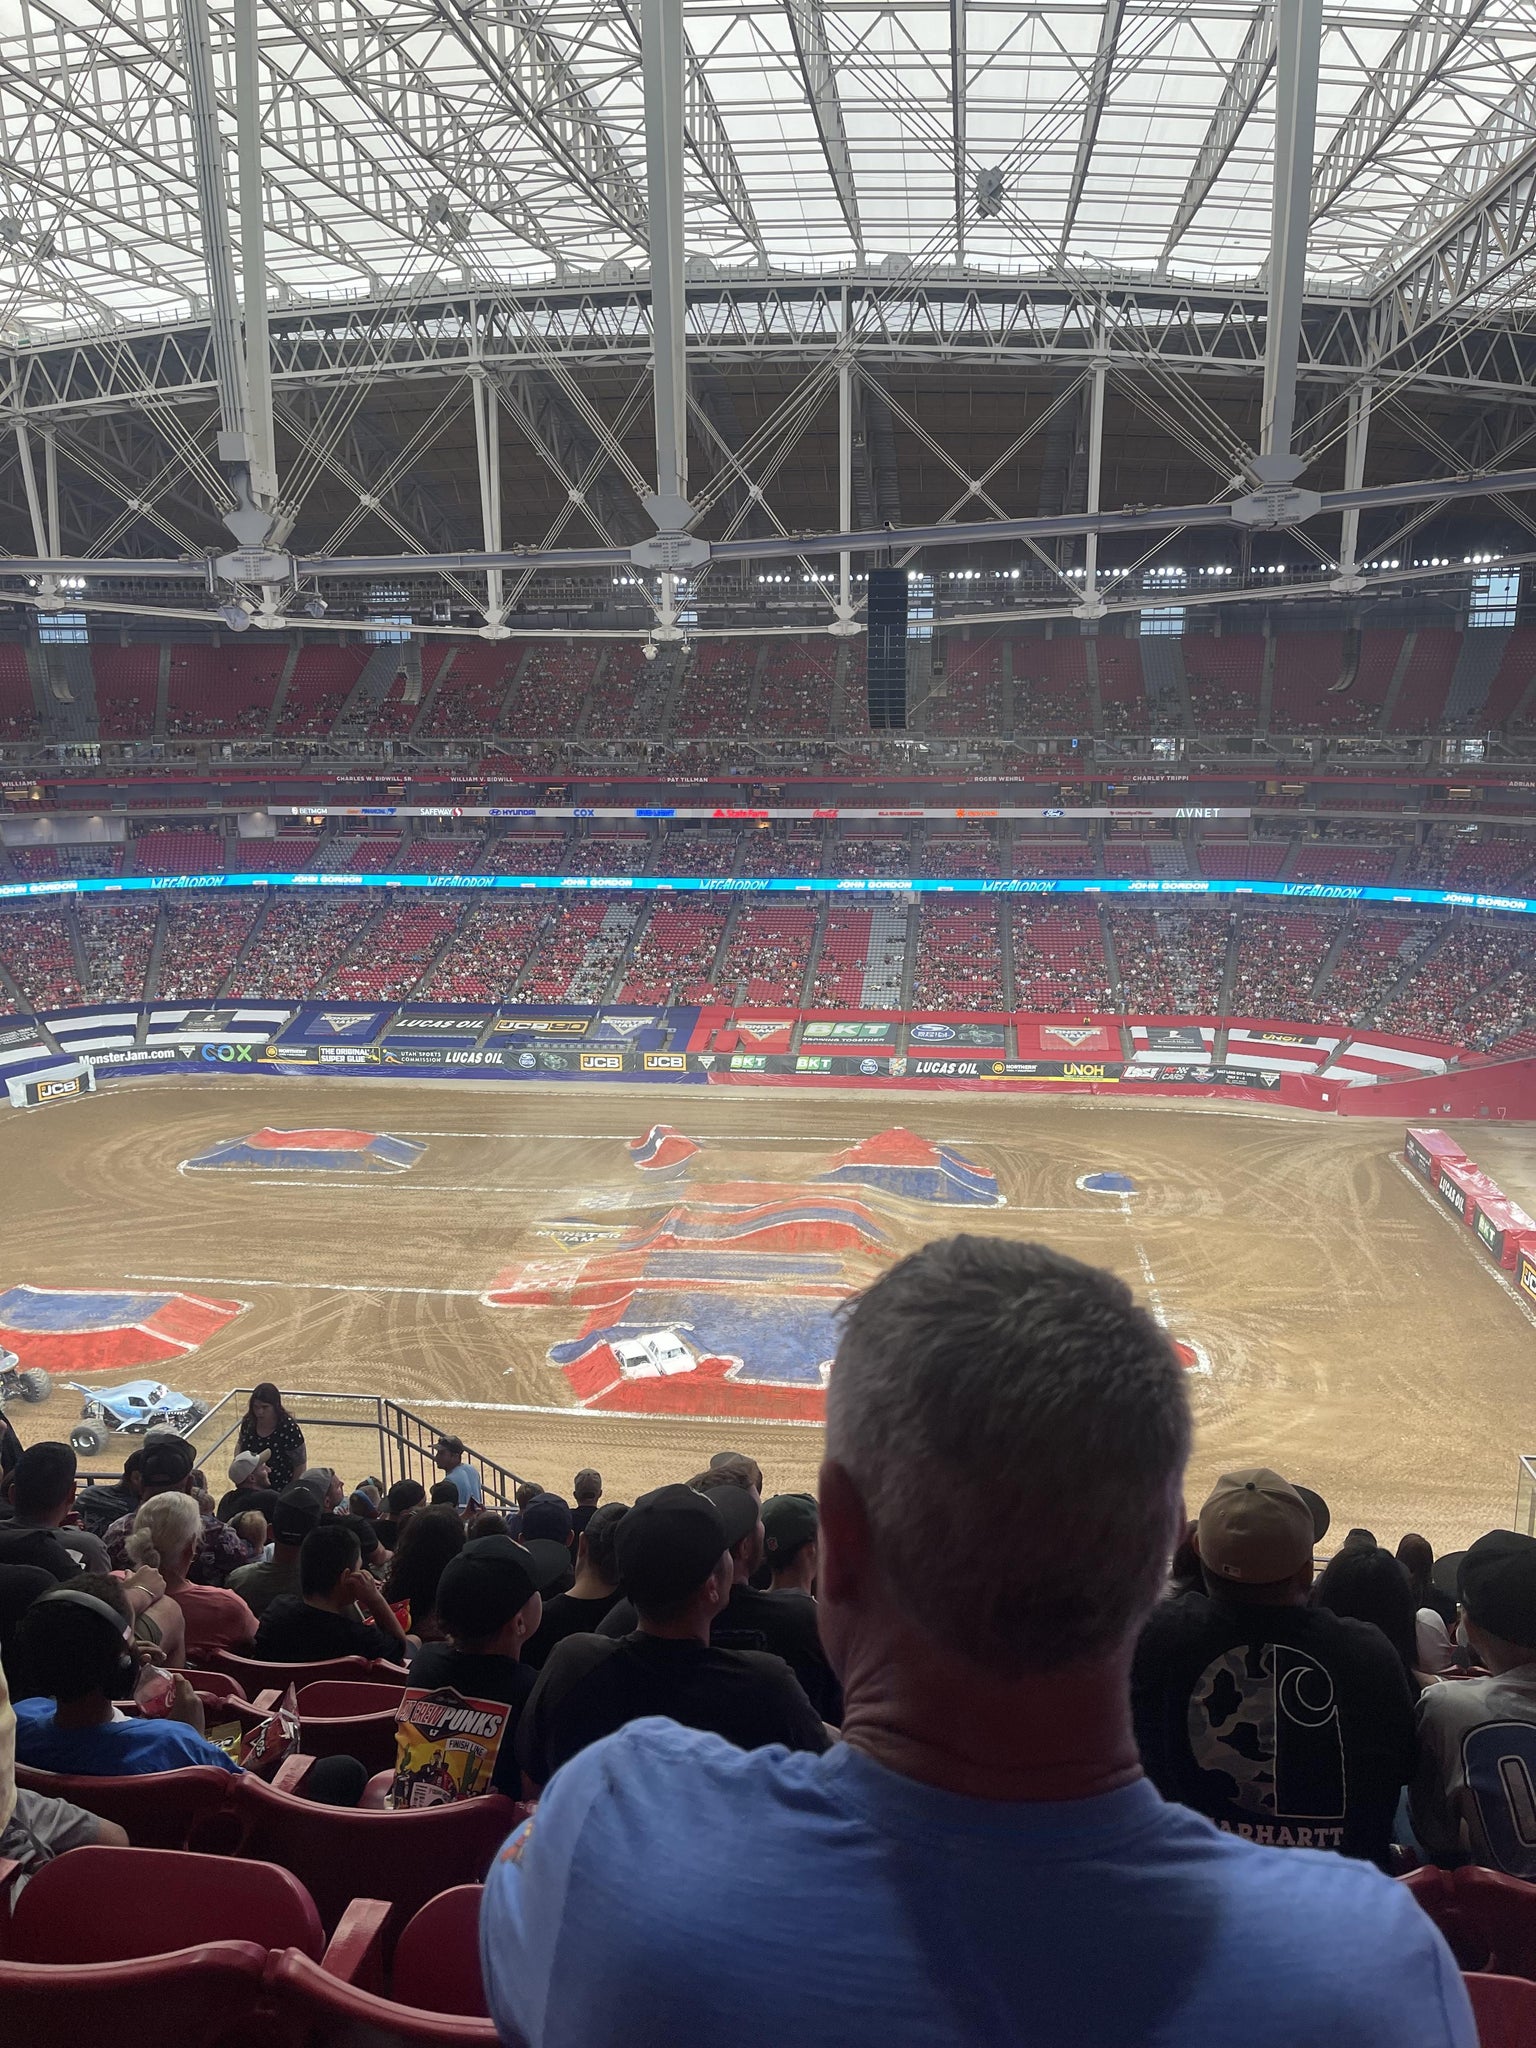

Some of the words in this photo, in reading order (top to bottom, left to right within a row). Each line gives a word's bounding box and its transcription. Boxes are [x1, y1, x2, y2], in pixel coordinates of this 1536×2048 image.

[1508, 780, 1536, 788] ADRIAN
[420, 808, 452, 816] SAFEWAY
[573, 809, 595, 817] COX
[1175, 808, 1220, 818] AVNET
[150, 875, 225, 889] MEGALODON
[291, 876, 318, 884] JOHN
[320, 876, 362, 884] GORDON
[426, 876, 496, 888] MEGALODON
[560, 879, 588, 887] JOHN
[590, 879, 633, 887] GORDON
[699, 878, 769, 890] MEGALODON
[836, 881, 865, 889] JOHN
[867, 881, 912, 889] GORDON
[981, 880, 1058, 892] MEGALODON
[29, 882, 78, 893] GORDON
[1127, 882, 1159, 890] JOHN
[1161, 882, 1210, 891] GORDON
[1281, 884, 1364, 899] MEGALODON
[1442, 893, 1474, 904] JOHN
[1476, 896, 1527, 910] GORDON
[396, 1019, 455, 1028] LUCAS
[456, 1020, 484, 1029] OIL
[499, 1022, 549, 1031] JCB
[805, 1023, 889, 1036] BKT
[1262, 1033, 1304, 1043] UNOH
[79, 1049, 175, 1065] MonsterJam.com
[201, 1043, 252, 1062] COX
[321, 1047, 335, 1055] THE
[445, 1052, 483, 1064] LUCAS
[484, 1052, 503, 1064] OIL
[583, 1057, 620, 1068] JCB
[647, 1056, 683, 1067] JCB
[731, 1055, 766, 1068] BKT
[796, 1057, 832, 1070] BKT
[915, 1061, 956, 1074] LUCAS
[957, 1062, 978, 1075] OIL
[1063, 1062, 1105, 1076] UNOH
[41, 1080, 77, 1097] JCB
[1438, 1176, 1456, 1205] LUCAS
[1454, 1191, 1465, 1216] OIL
[536, 1230, 622, 1239] MONSTER
[1478, 1213, 1496, 1245] BKT
[437, 1706, 503, 1738] PUNKS
[449, 1739, 469, 1750] FINISH
[469, 1742, 485, 1756] LINE
[1208, 1817, 1345, 1847] ARHARTT
